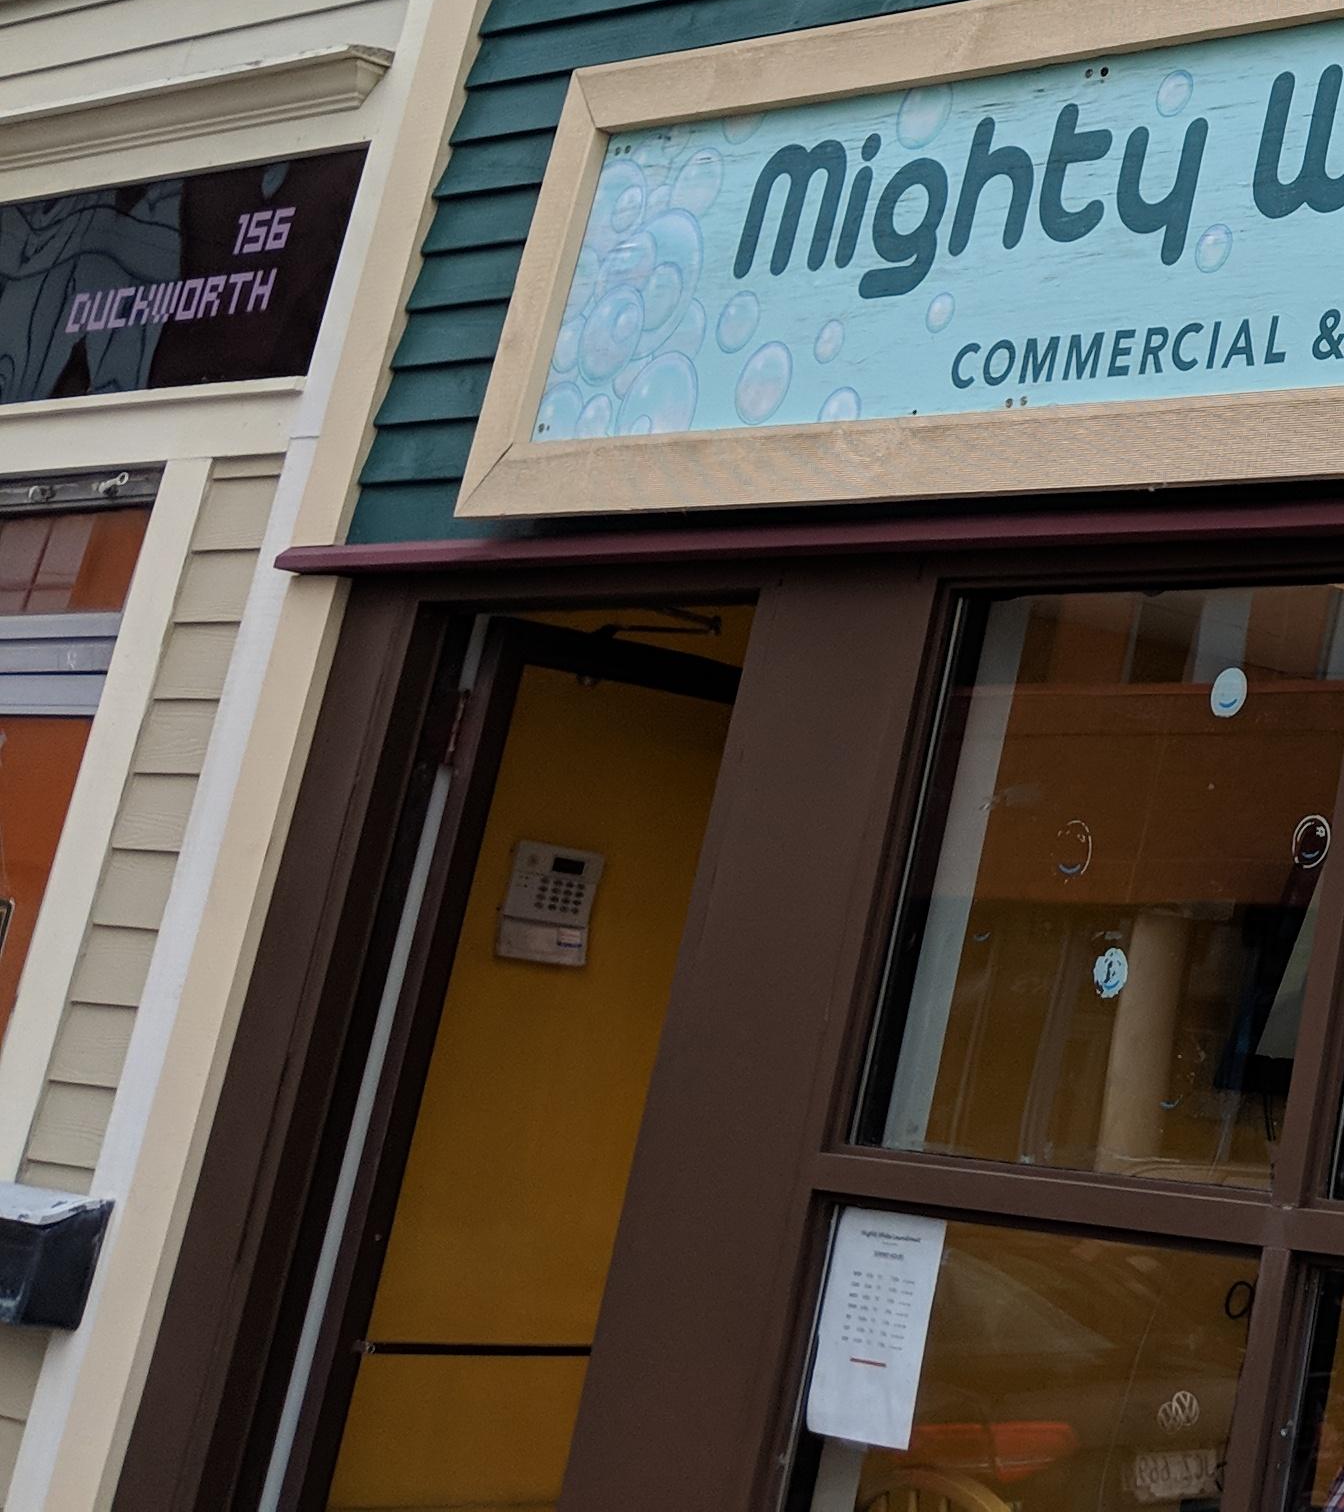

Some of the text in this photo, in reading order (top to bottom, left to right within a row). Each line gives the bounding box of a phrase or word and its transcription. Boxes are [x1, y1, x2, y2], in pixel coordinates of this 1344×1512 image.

[232, 206, 297, 256] 156
[732, 102, 1209, 300] Mighty
[64, 268, 278, 334] DUCKWORTH
[950, 315, 1287, 389] COMMERCIAL
[1310, 308, 1344, 360] &
